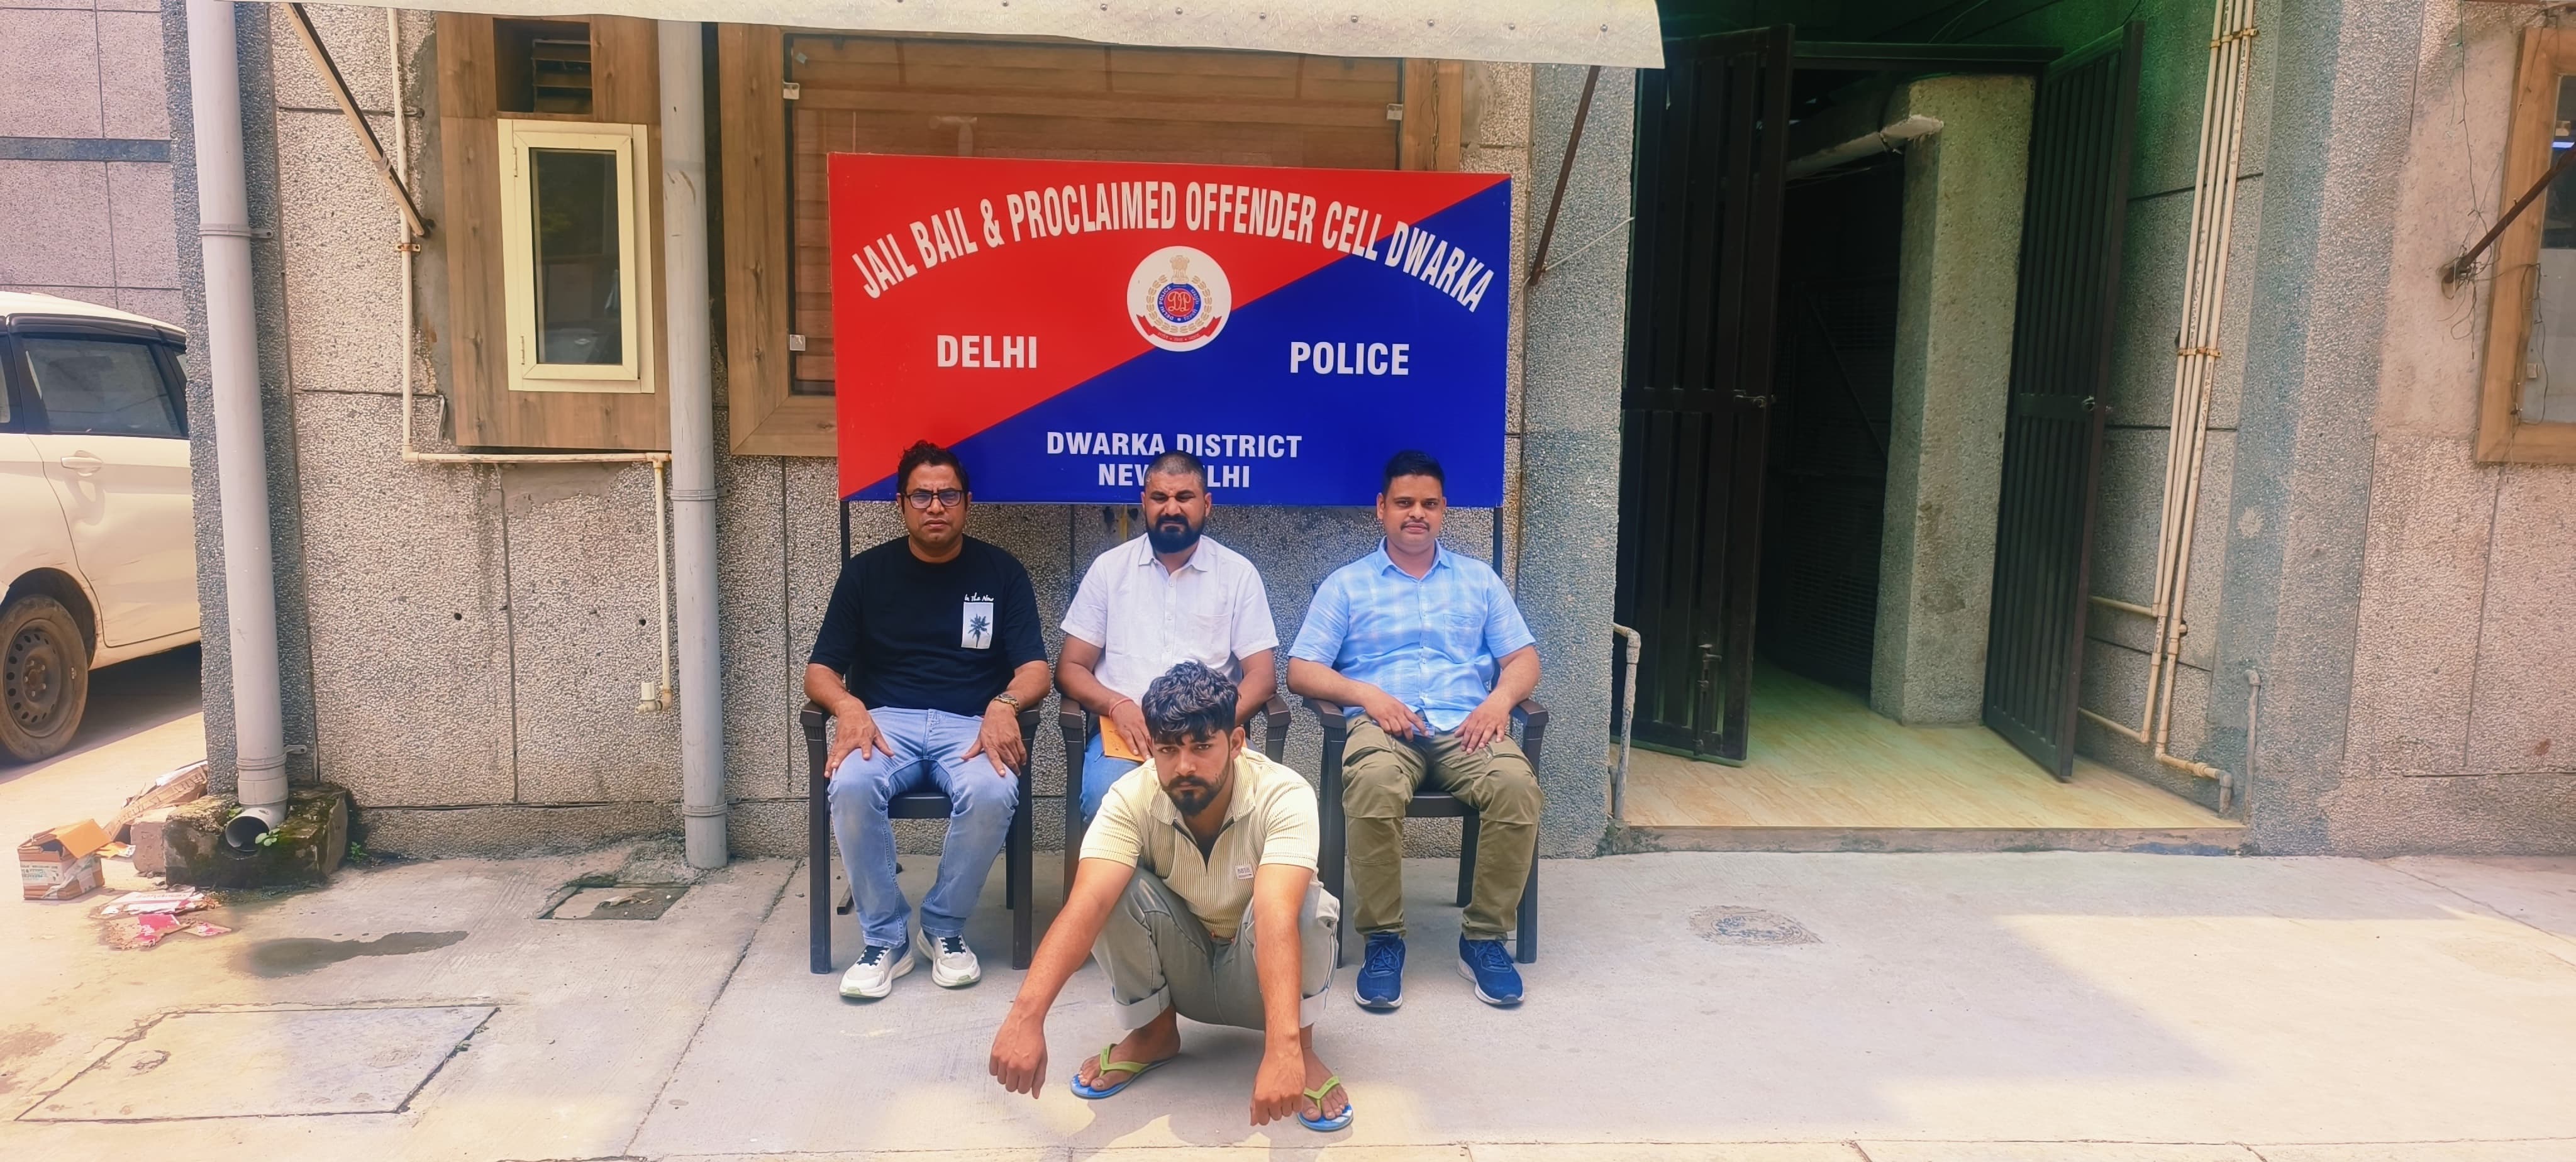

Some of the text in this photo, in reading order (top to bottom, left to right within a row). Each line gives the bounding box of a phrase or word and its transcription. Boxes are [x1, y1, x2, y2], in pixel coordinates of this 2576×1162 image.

[852, 181, 1494, 313] JAIL BAIL & PROCLAIMED OFFENDER CELL DWARKA
[937, 335, 1037, 368] DELHI
[1290, 341, 1409, 375] POLICE
[1047, 431, 1302, 458] DWARKA DISTRICT
